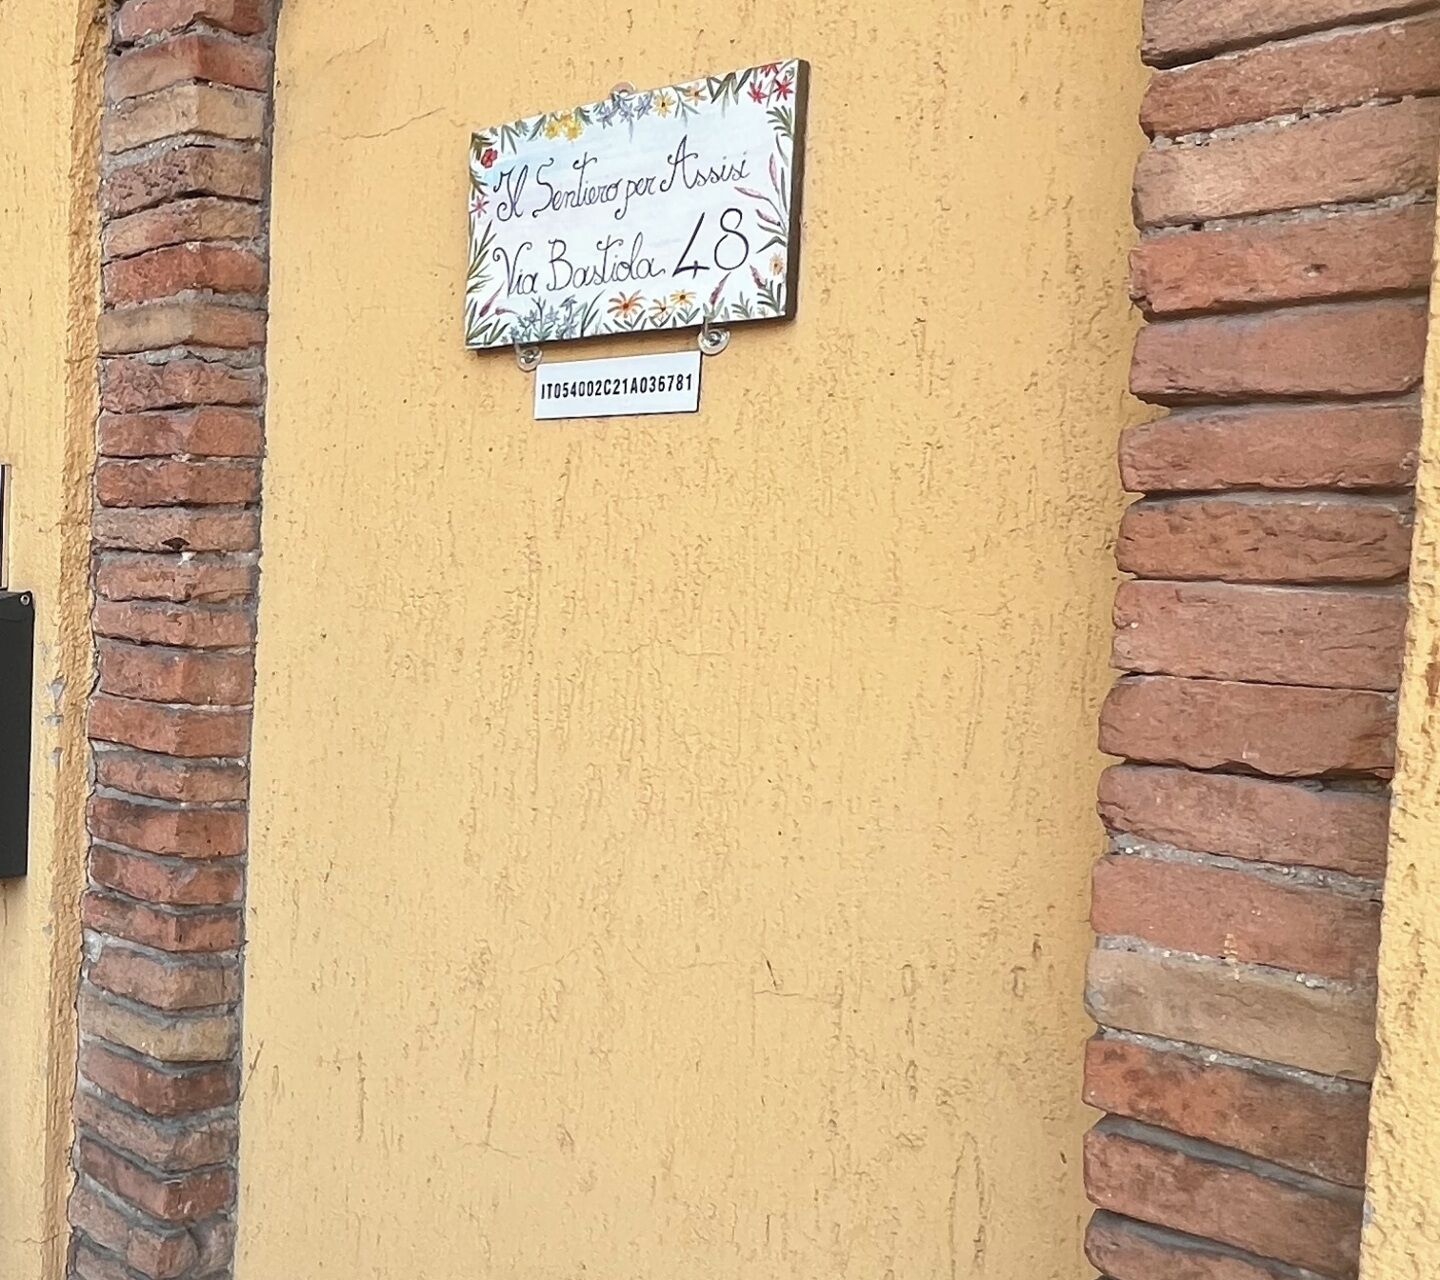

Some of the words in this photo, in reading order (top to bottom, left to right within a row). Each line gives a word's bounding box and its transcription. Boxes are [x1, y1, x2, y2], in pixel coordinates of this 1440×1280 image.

[492, 164, 530, 222] Il
[532, 151, 623, 218] Sentiero
[614, 175, 657, 220] per
[660, 134, 751, 193] Assisi
[492, 241, 539, 298] Via
[546, 231, 666, 292] Bastiola
[672, 207, 750, 279] 48
[540, 373, 693, 400] IT054002C21A036781
